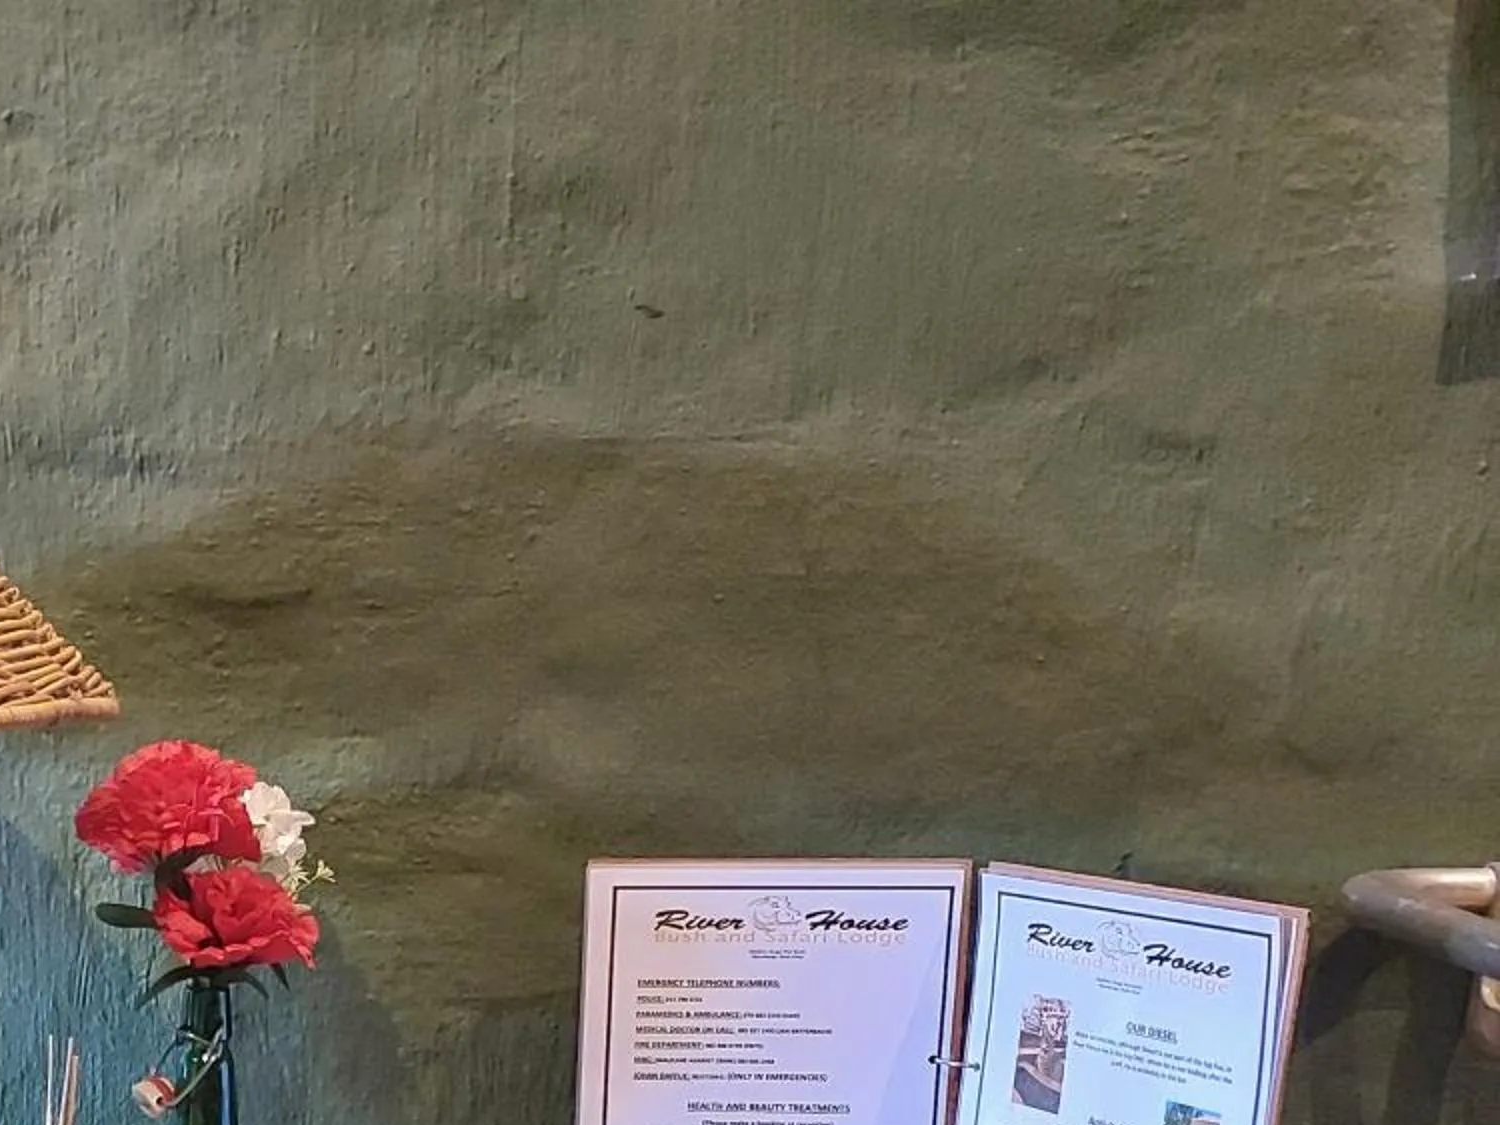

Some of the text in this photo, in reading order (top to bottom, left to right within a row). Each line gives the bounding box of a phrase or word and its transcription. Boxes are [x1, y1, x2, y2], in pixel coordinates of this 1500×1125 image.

[653, 909, 910, 932] River House
[654, 928, 907, 947] Bush and Safari Lodge
[1026, 922, 1234, 980] River House
[686, 979, 734, 989] TELEPHONE
[1167, 971, 1231, 996] Lodge
[1125, 1020, 1179, 1045] OUR DIESEL
[686, 1101, 852, 1113] HEALTH AND BEAUTY TREATMENTS
